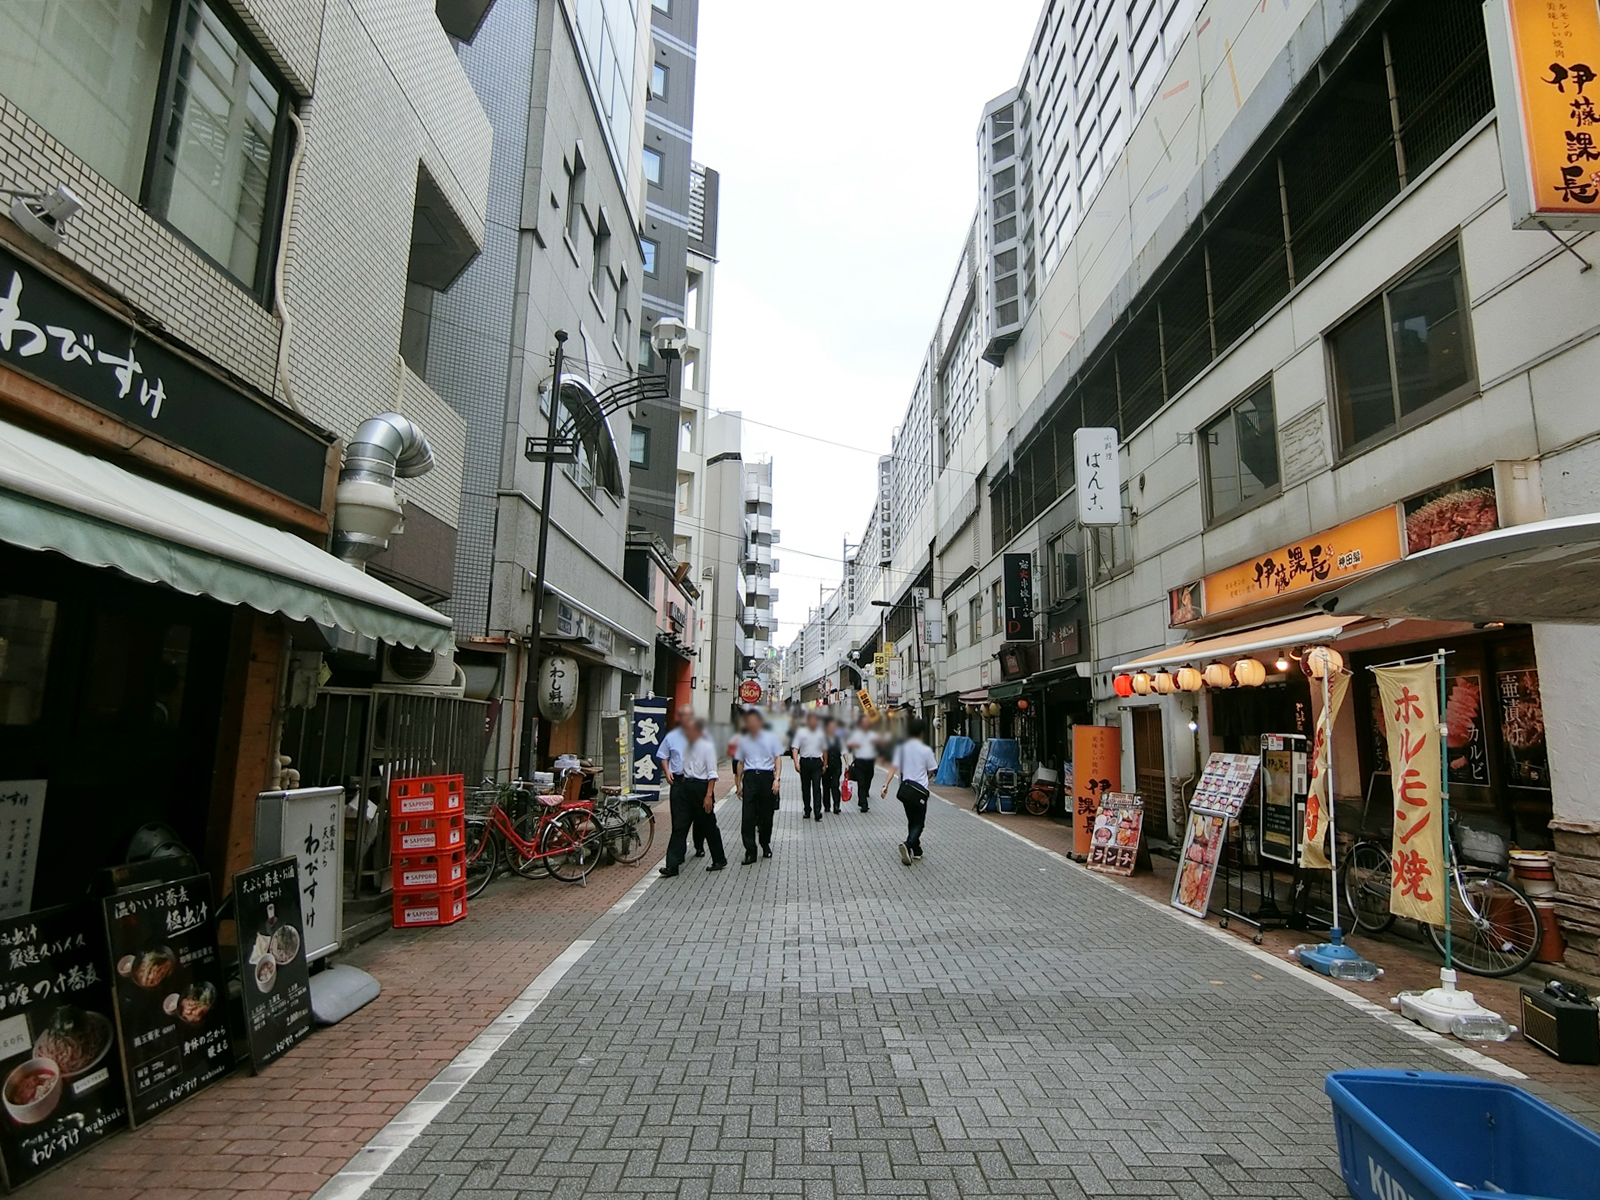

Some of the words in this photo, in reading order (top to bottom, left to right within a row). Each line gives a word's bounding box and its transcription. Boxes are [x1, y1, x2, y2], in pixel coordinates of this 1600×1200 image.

[1541, 63, 1600, 203] 伊藤課長
[0, 270, 167, 418] わびすけ
[1252, 545, 1331, 594] 伊藤課長
[1467, 725, 1484, 780] カルビ
[408, 800, 434, 808] SAPPORO
[1392, 686, 1433, 902] ホルモン焼
[329, 803, 337, 852] つけ蕎麦
[410, 836, 435, 844] SAPPORO
[303, 822, 320, 928] わびすけ
[411, 872, 436, 881] SAPPORO
[1094, 849, 1132, 866] ランチ
[115, 885, 190, 919] 温かいお蕎麦
[412, 910, 438, 918] SAPPORO
[169, 1076, 197, 1100] わびすけ
[31, 1127, 79, 1165] わびすけ
